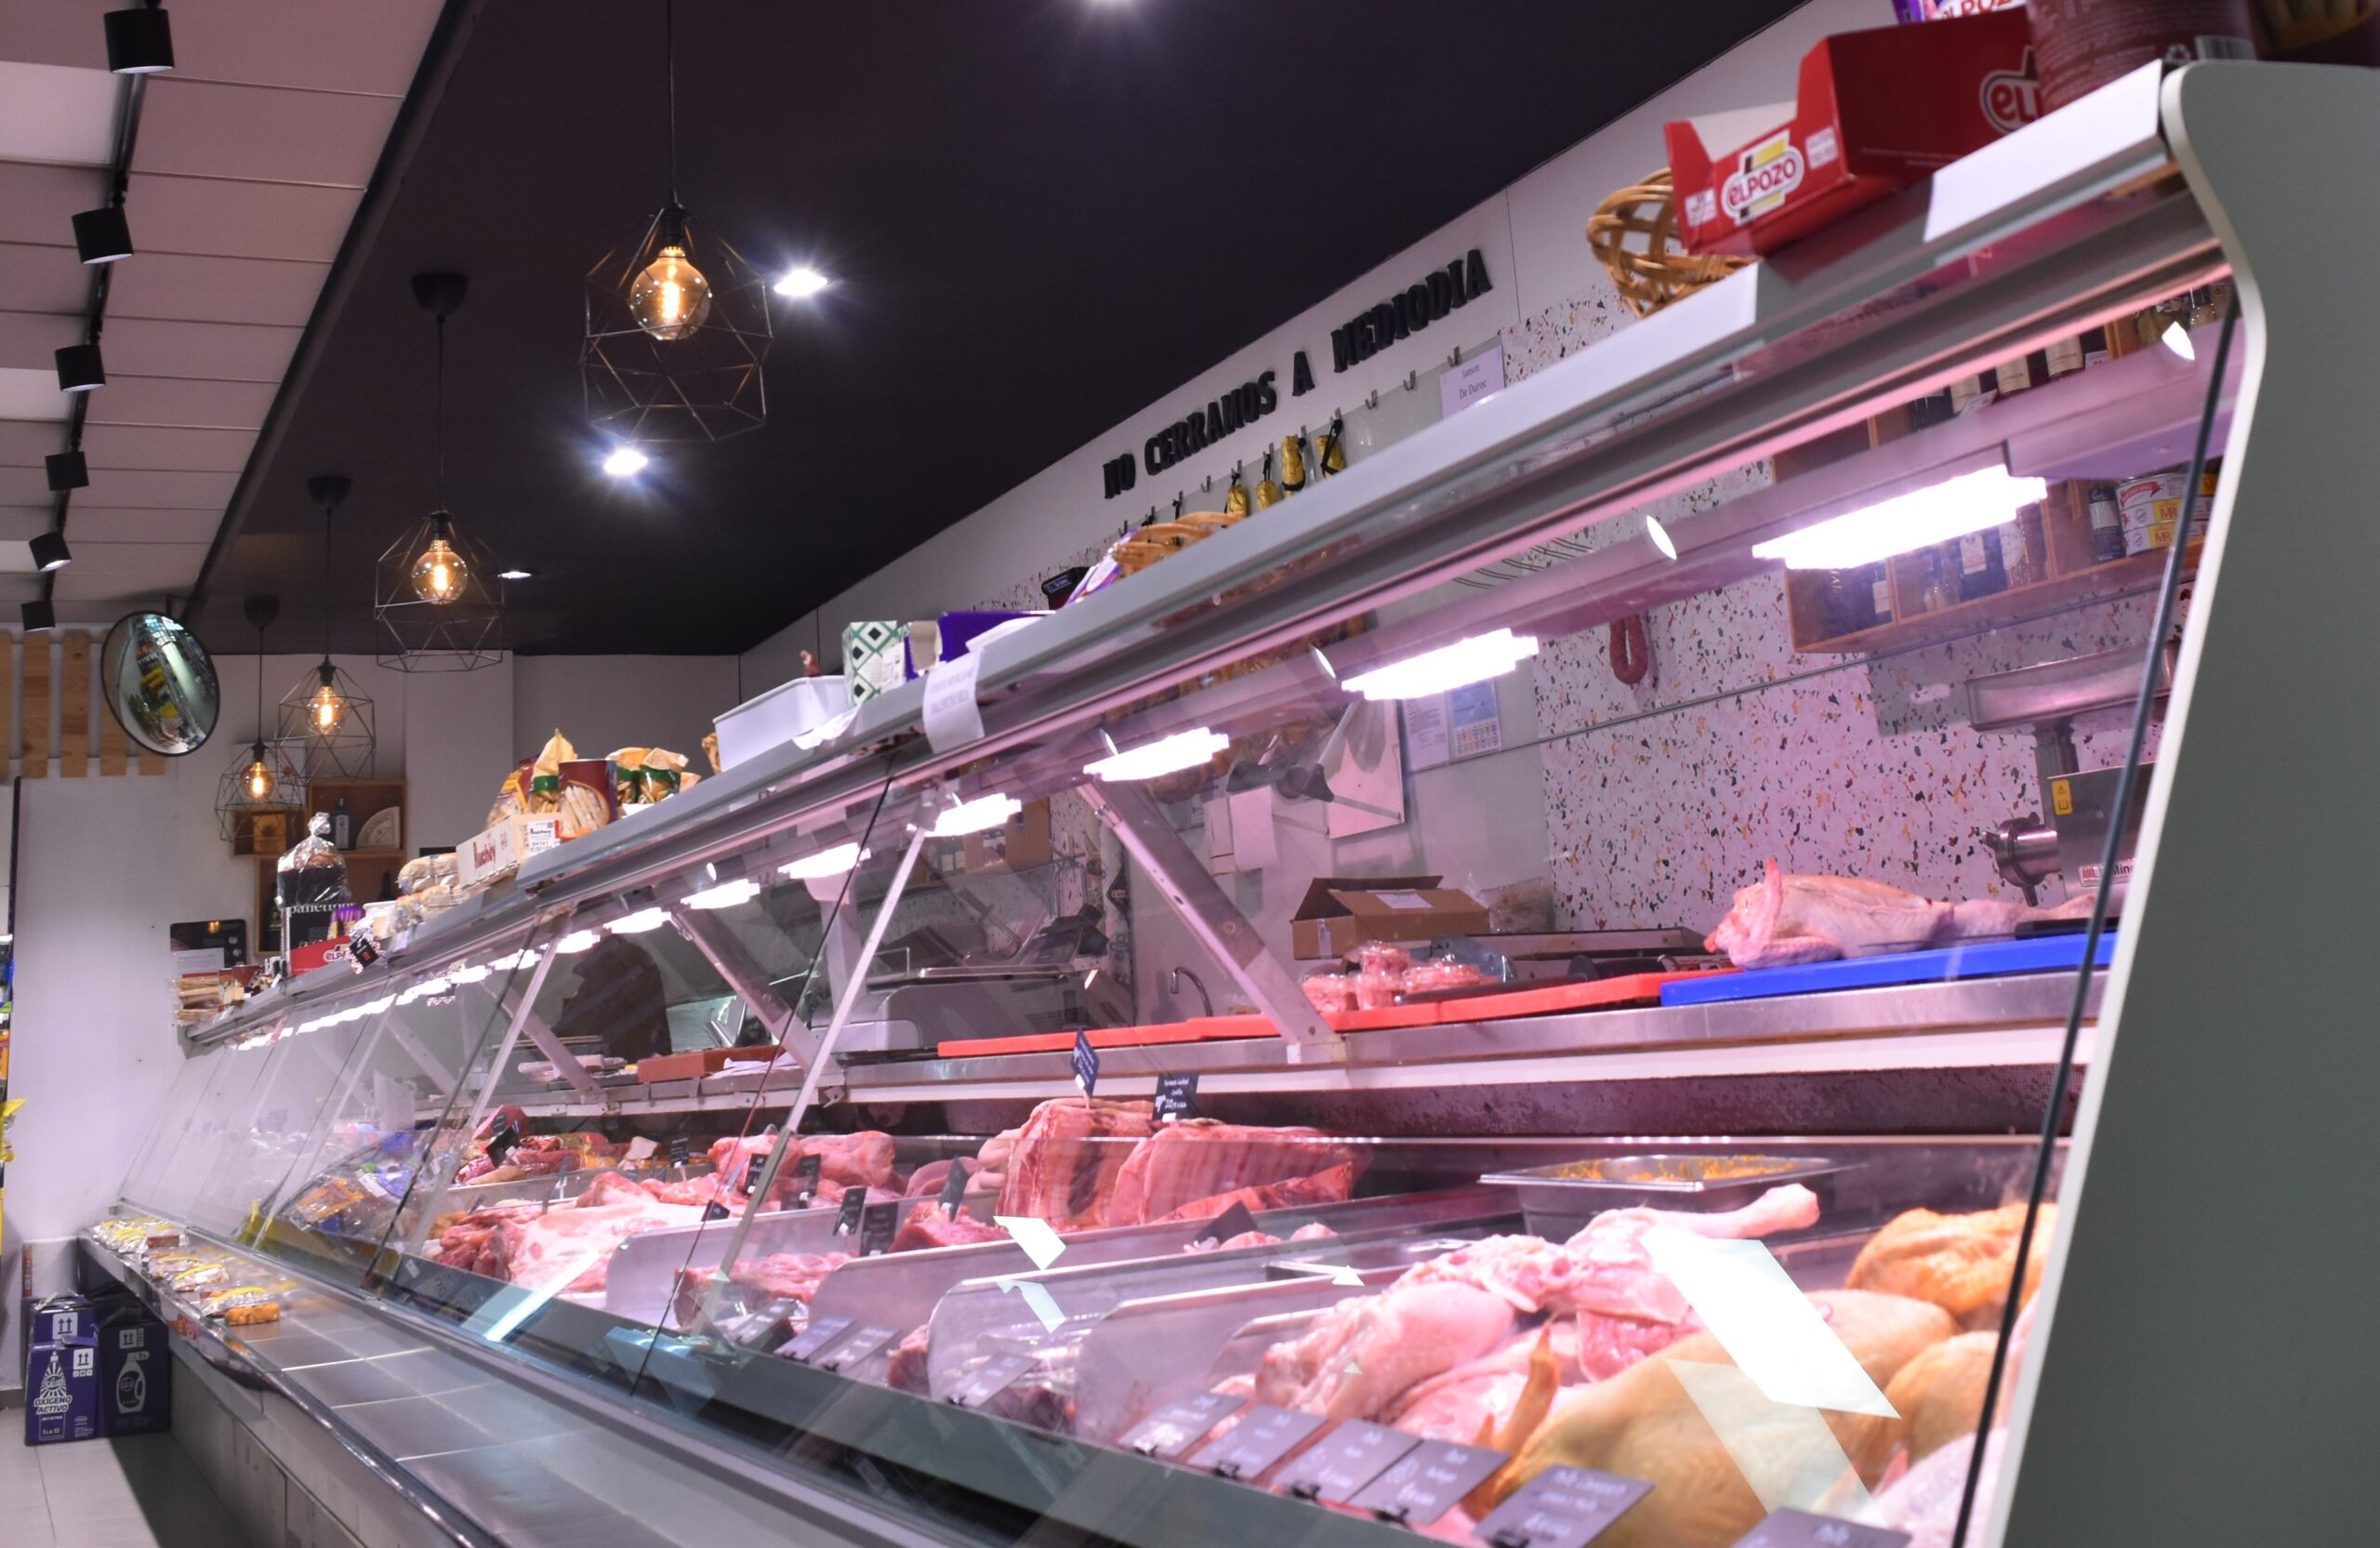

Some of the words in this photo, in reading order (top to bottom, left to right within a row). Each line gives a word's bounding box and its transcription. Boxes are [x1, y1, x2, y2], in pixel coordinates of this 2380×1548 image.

[1103, 454, 1136, 498] NO
[1144, 371, 1277, 476] CERRAMOS
[1292, 351, 1316, 396] A
[1331, 249, 1493, 373] MEDIODIA
[37, 1405, 68, 1413] ACTIVO
